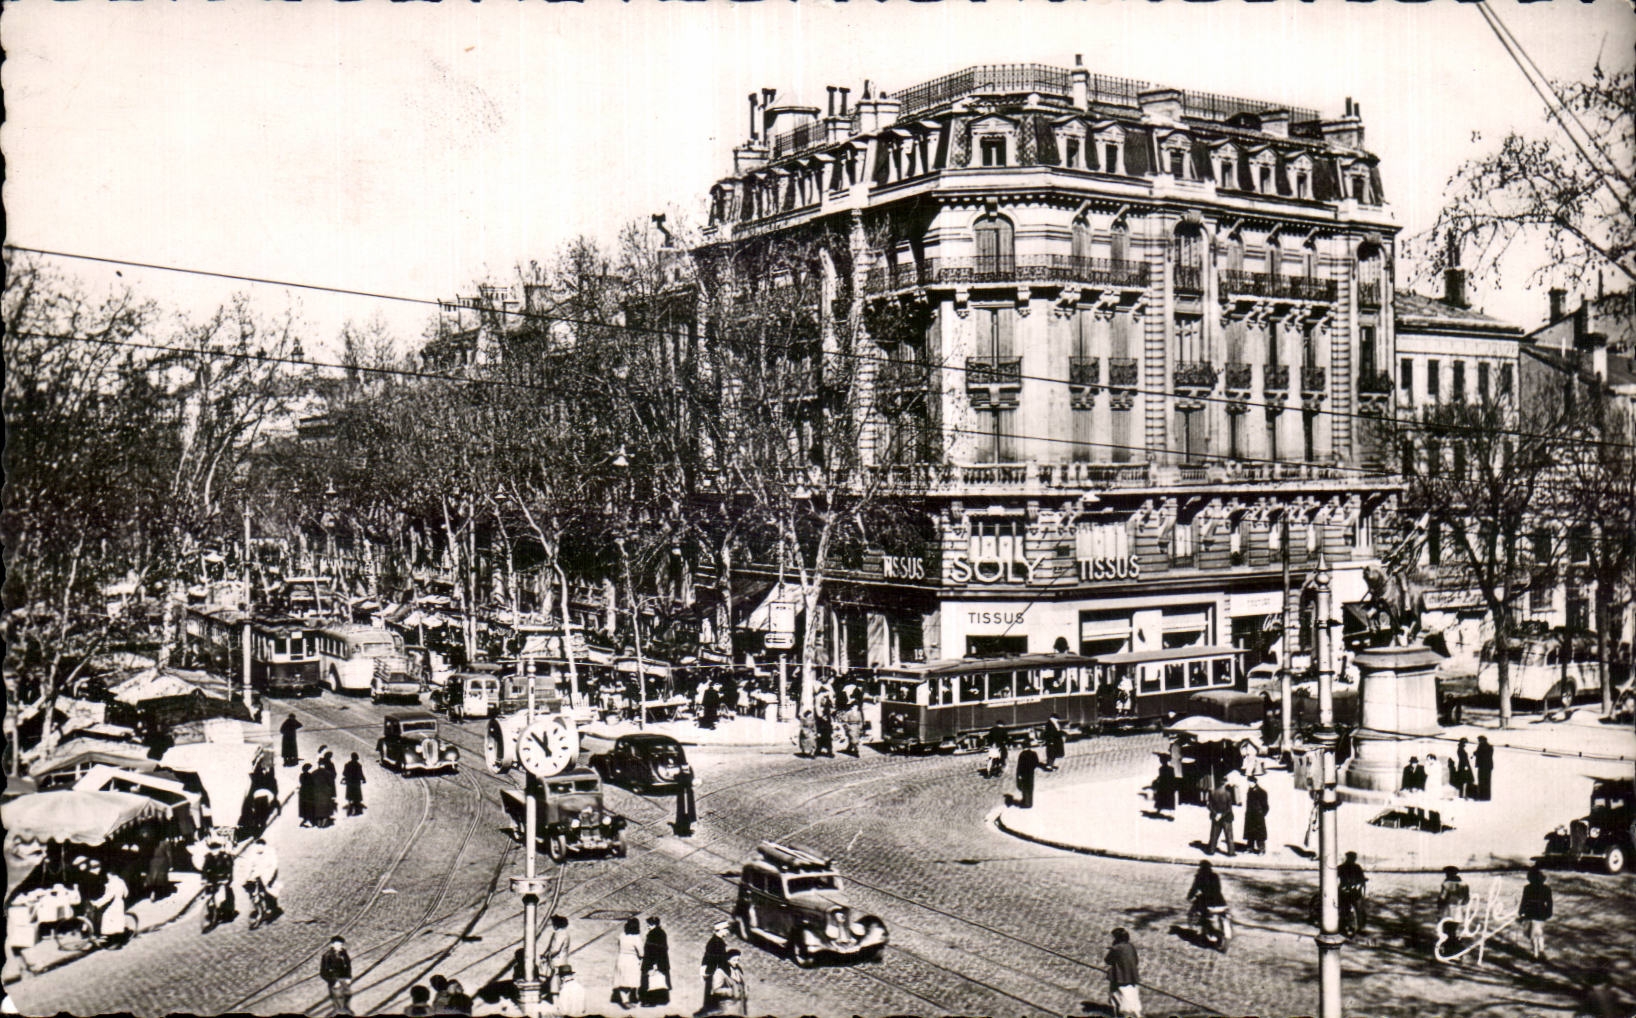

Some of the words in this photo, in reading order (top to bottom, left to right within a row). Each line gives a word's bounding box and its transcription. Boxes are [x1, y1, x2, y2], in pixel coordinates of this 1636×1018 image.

[882, 556, 925, 579] TISSUS
[949, 554, 1045, 582] SOLY
[1078, 555, 1140, 580] TISSUS
[968, 612, 1024, 624] TISSUS
